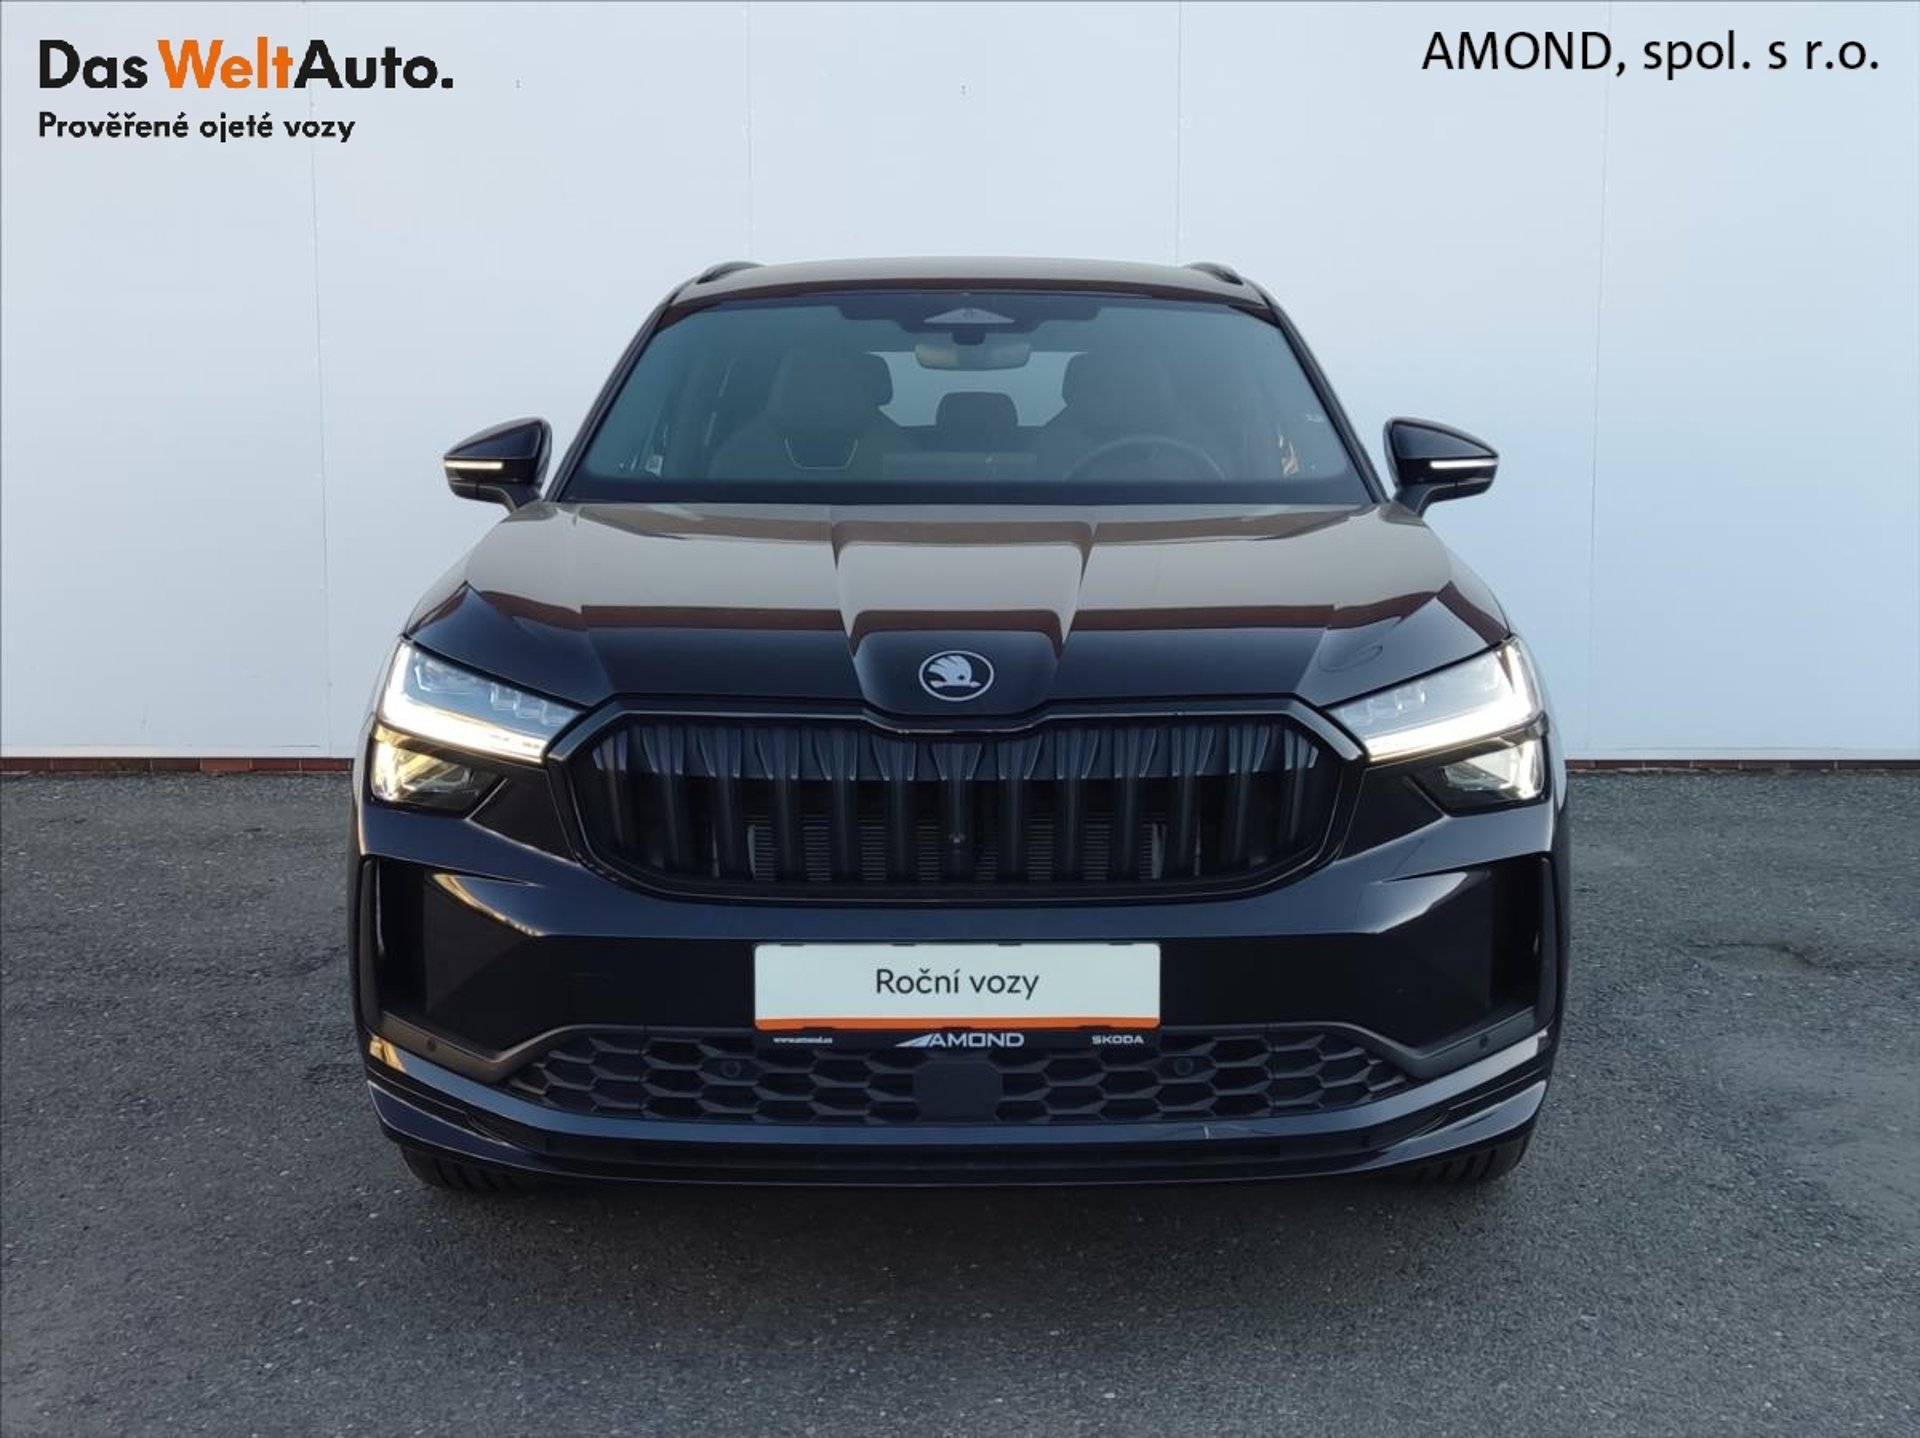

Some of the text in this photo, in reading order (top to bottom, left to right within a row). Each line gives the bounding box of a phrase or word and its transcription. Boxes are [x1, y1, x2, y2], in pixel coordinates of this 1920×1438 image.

[876, 968, 1040, 1001] Roční vozy
[928, 1032, 1025, 1048] AMOND
